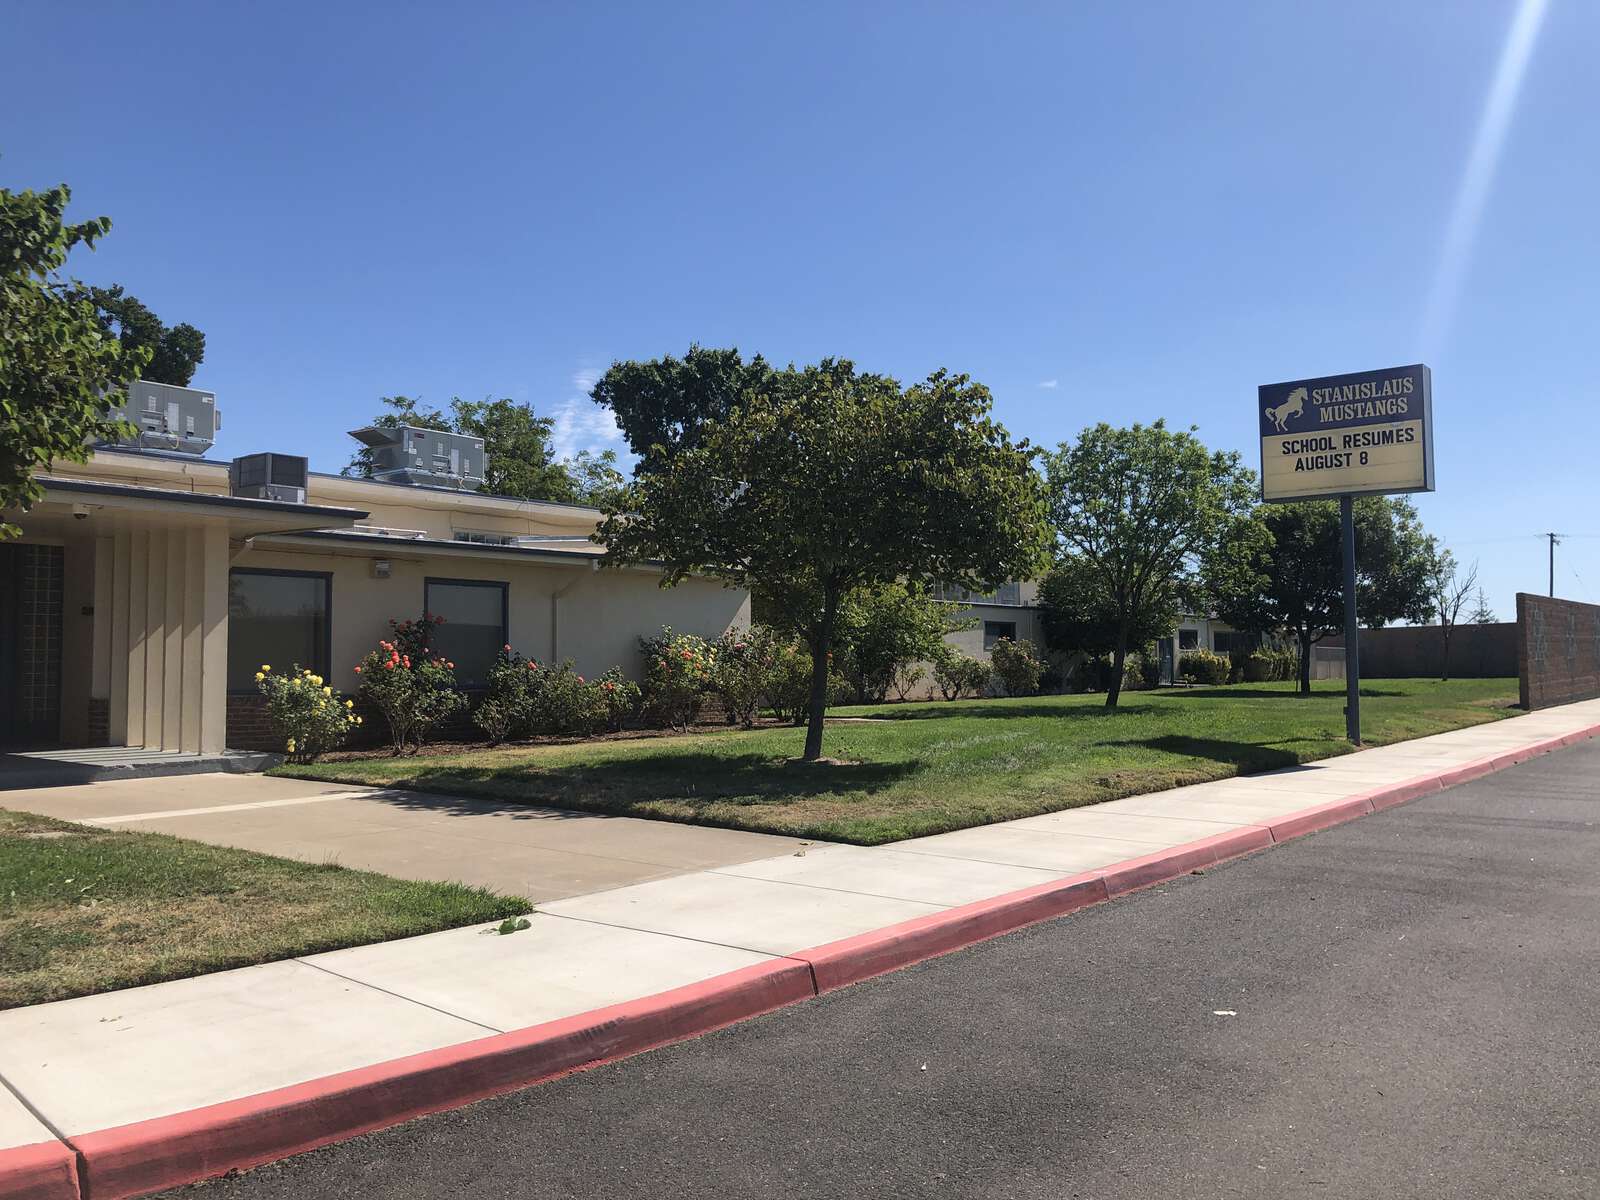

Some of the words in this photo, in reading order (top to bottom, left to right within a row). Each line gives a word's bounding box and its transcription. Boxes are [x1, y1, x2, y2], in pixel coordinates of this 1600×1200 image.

[1312, 377, 1414, 405] STANISLAUS
[1319, 397, 1408, 423] MUSTANGS
[1282, 436, 1337, 455] SCHOOL
[1343, 427, 1415, 449] RESUMES
[1295, 452, 1353, 472] AUGUST
[1359, 451, 1369, 466] 8
